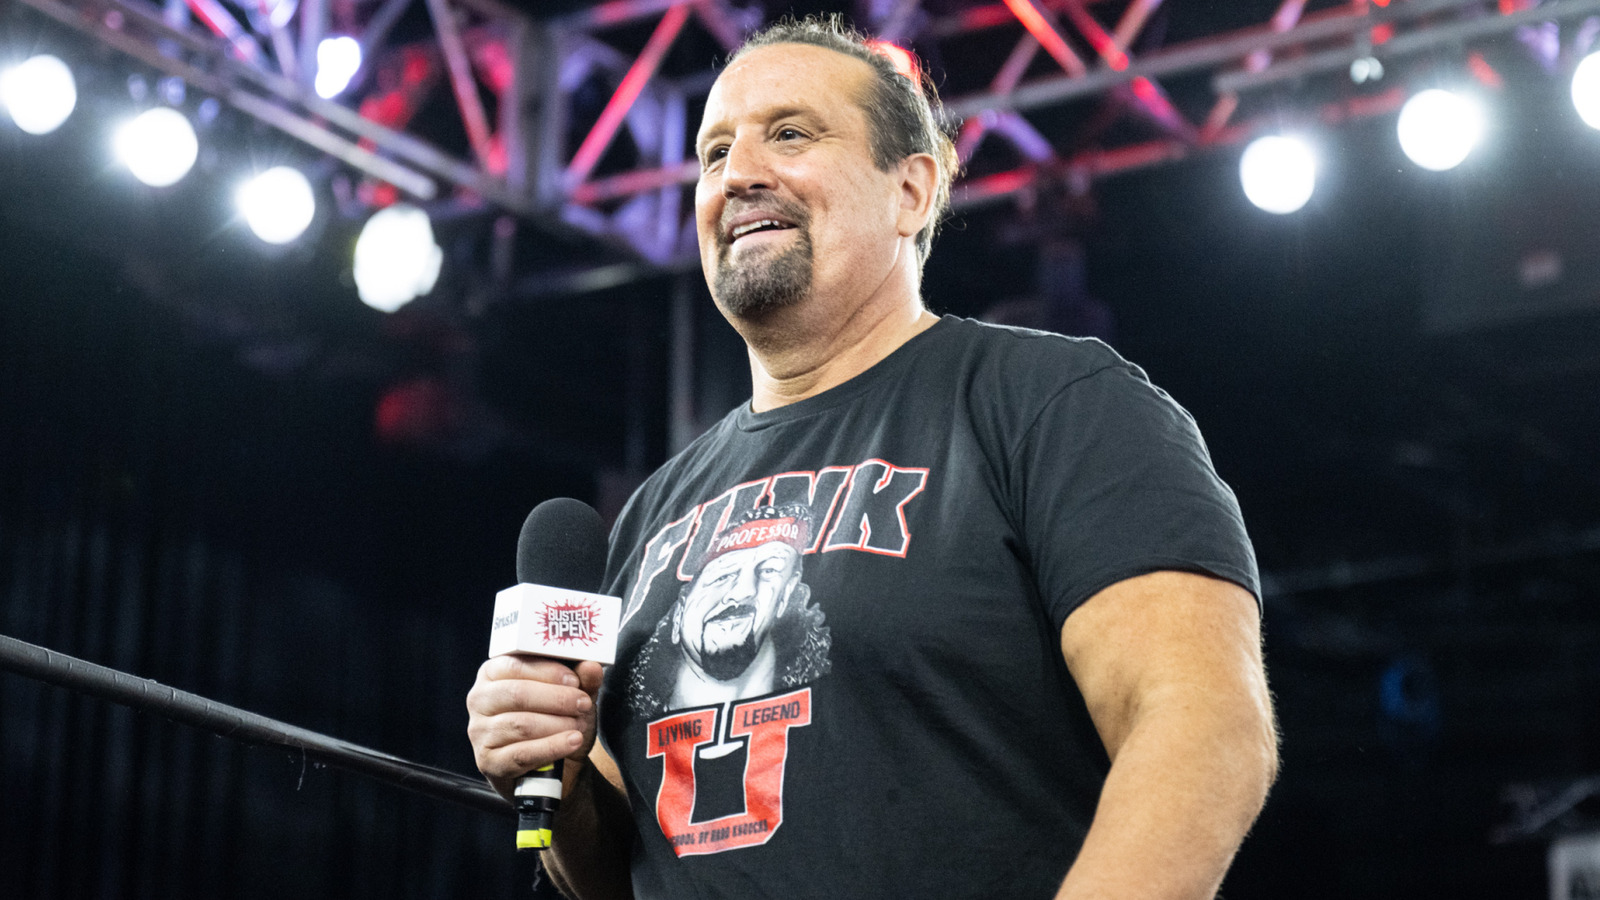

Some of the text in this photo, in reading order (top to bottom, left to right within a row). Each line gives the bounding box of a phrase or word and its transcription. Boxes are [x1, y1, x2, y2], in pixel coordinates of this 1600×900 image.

[618, 458, 930, 631] FUNK
[716, 523, 799, 552] PROFESSOR
[548, 607, 589, 622] BUSTED
[548, 621, 590, 640] OPEN
[658, 700, 800, 747] LIVING LEGEND
